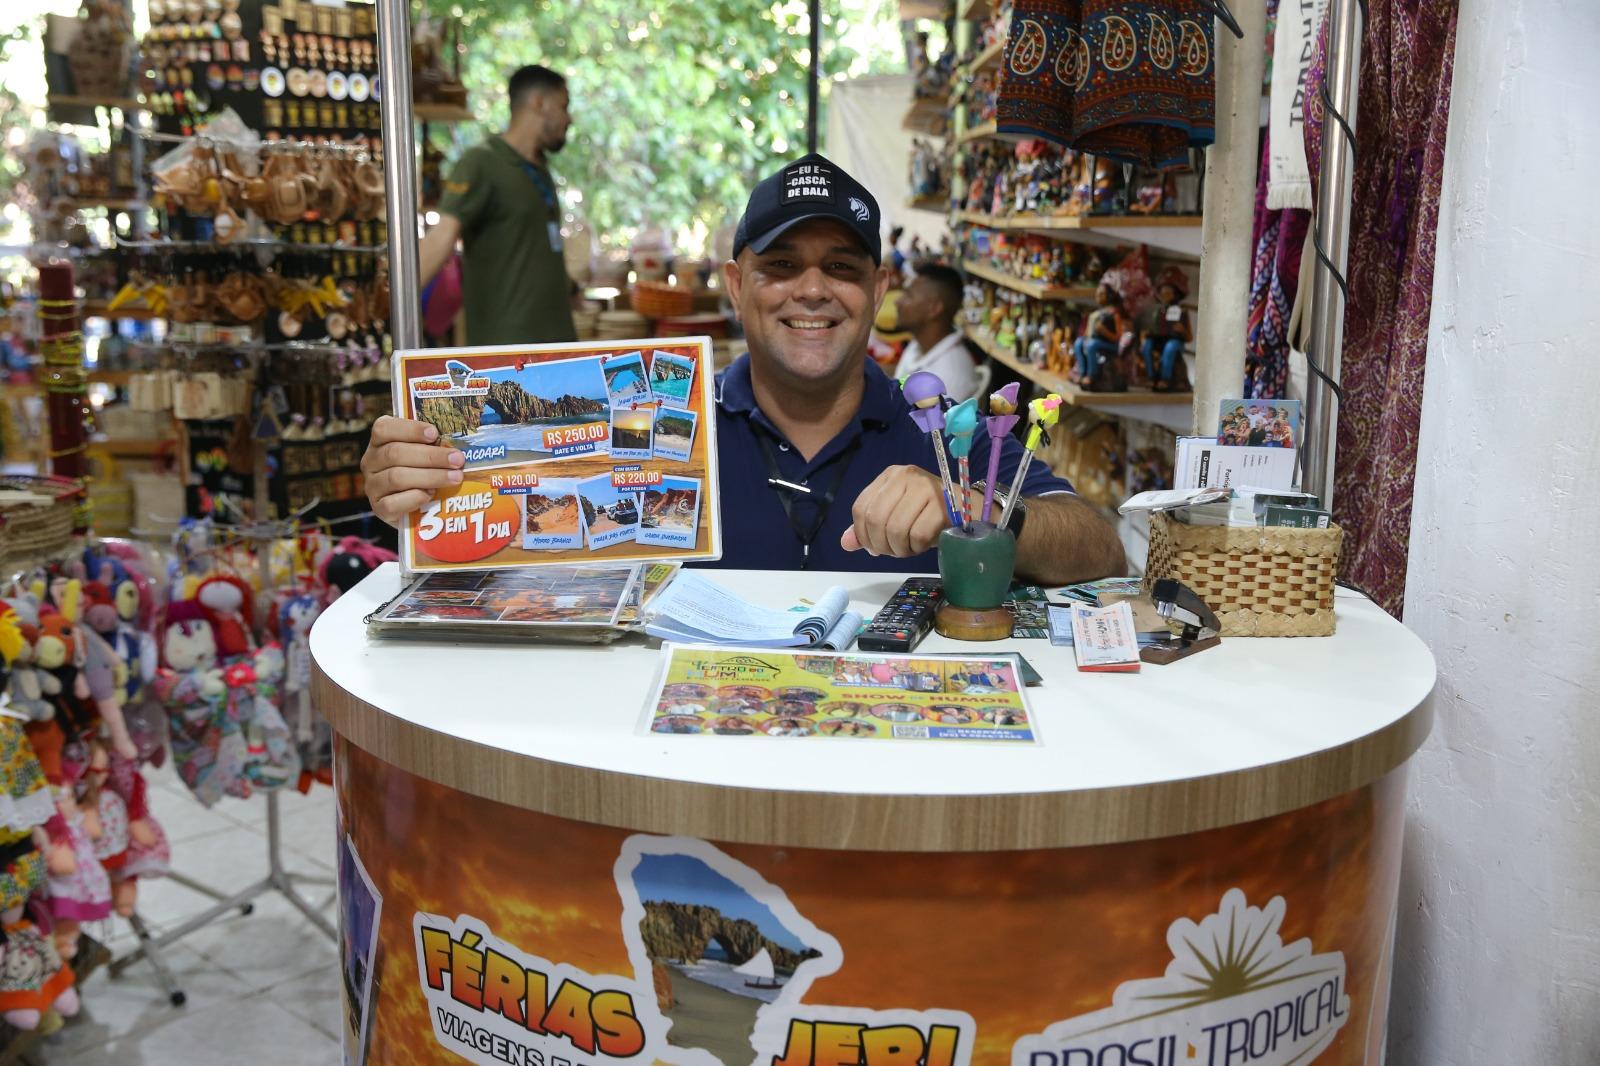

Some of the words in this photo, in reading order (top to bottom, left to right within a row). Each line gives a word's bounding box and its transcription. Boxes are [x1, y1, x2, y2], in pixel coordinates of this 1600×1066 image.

[799, 165, 811, 174] EU
[791, 176, 827, 186] CASCA
[788, 188, 801, 198] DE
[802, 187, 829, 197] BALA
[547, 431, 562, 446] R$
[564, 425, 604, 443] 250,00
[554, 446, 569, 456] BATE
[575, 444, 594, 453] VOLTA
[492, 475, 503, 487] R$
[506, 473, 538, 486] 120,00
[614, 473, 626, 485] R$
[628, 471, 659, 484] 220,00
[445, 492, 493, 514] PRAIAS
[418, 499, 444, 541] 3
[445, 516, 467, 534] EM
[470, 511, 485, 544] 1
[487, 521, 511, 541] DIA
[841, 693, 905, 701] SHOW
[929, 695, 1010, 704] HUMOR
[421, 929, 646, 1058] FÉRIAS
[1201, 976, 1345, 1066] TROPICAL
[437, 1007, 544, 1066] VIAGENS
[771, 1018, 960, 1066] JERI
